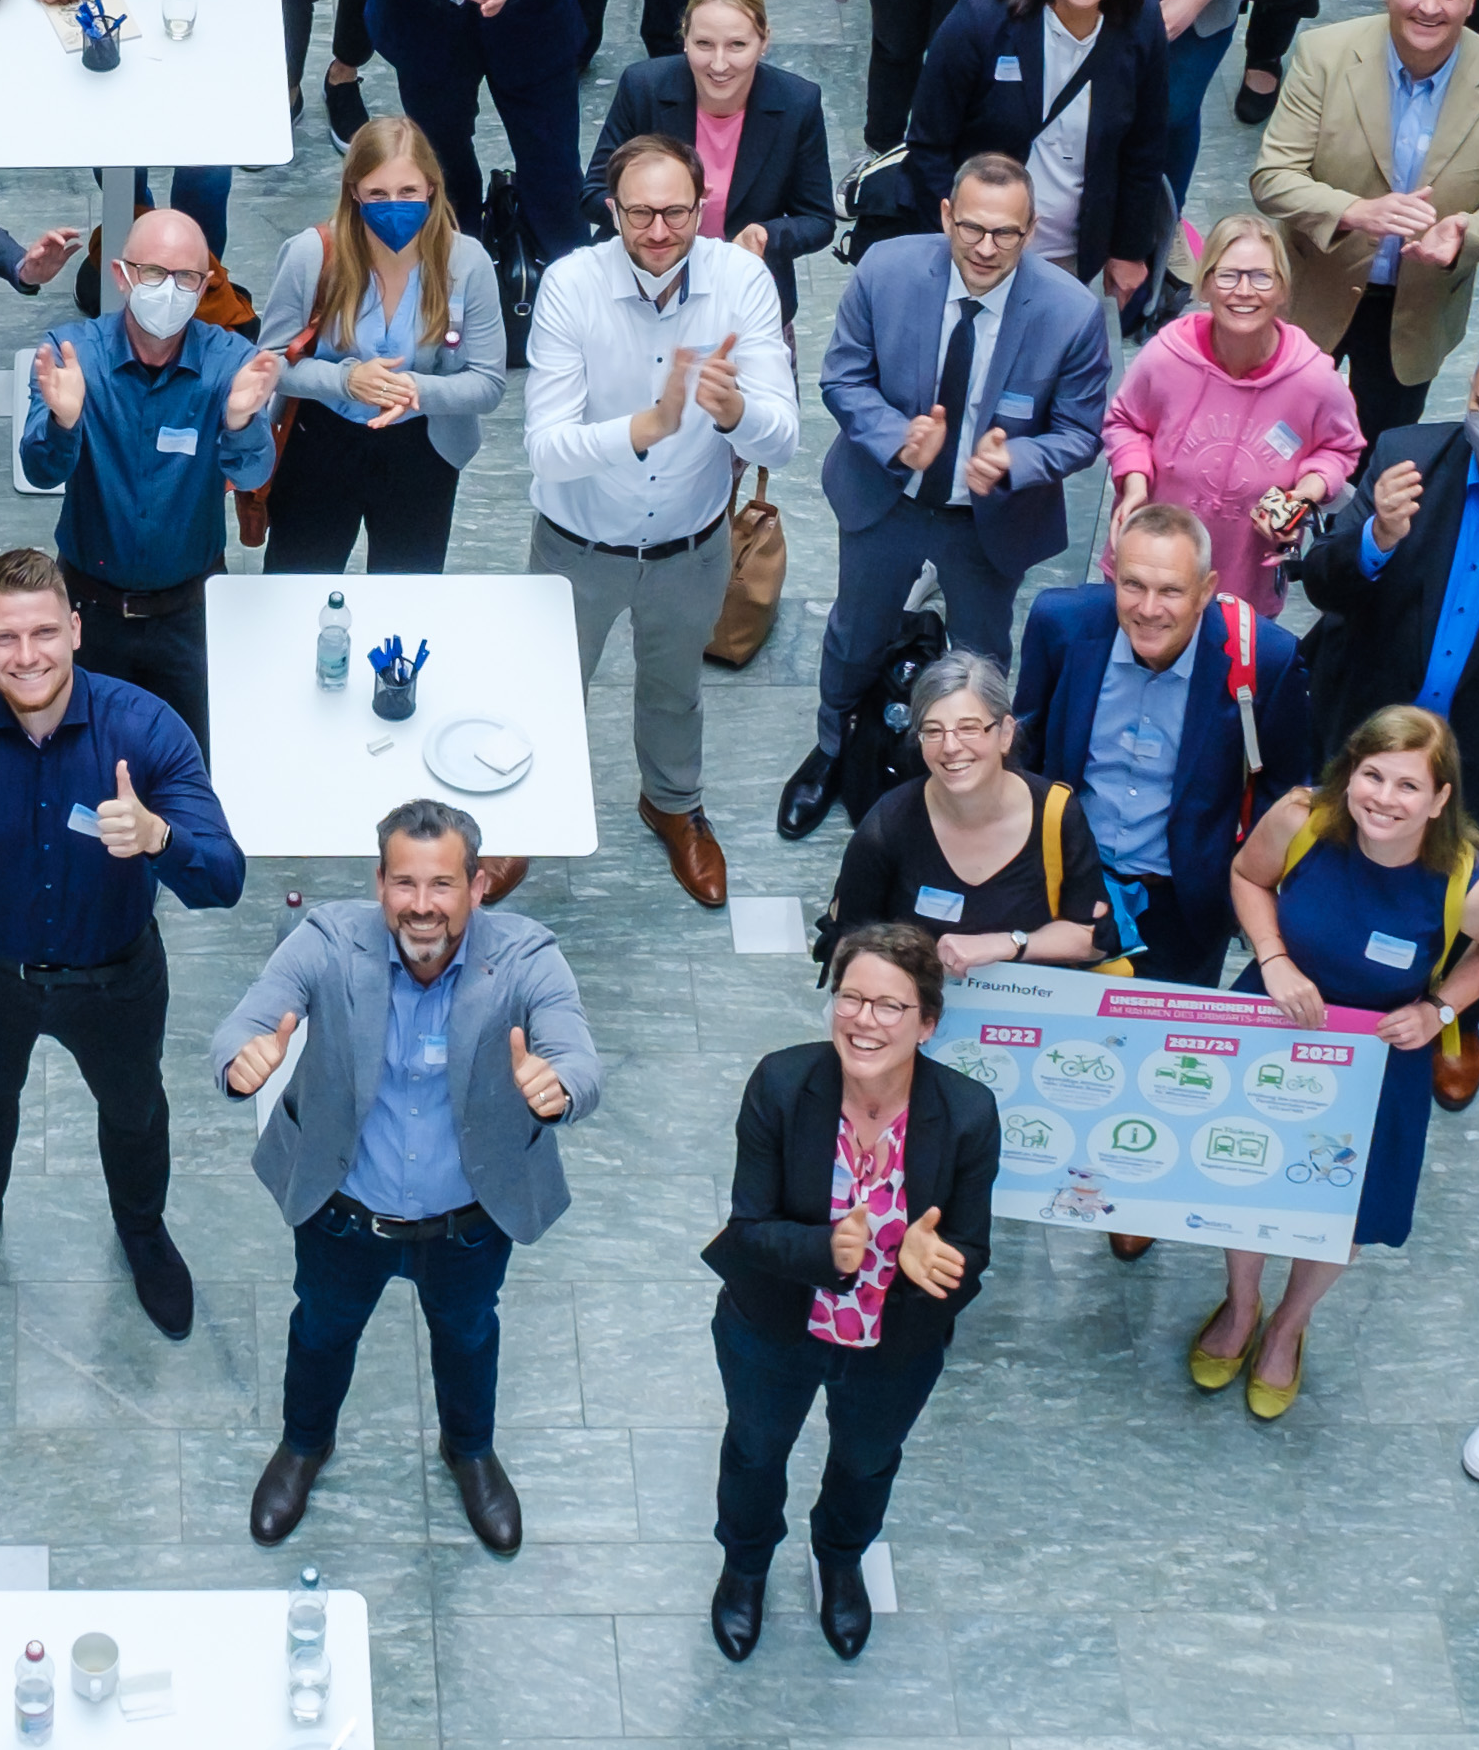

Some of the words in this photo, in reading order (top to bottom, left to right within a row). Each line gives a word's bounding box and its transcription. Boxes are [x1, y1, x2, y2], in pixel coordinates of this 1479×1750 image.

[967, 978, 1054, 998] Fraunhofer
[1109, 995, 1164, 1008] UNSERE
[1167, 998, 1254, 1014] AMBITIONEN
[985, 1028, 1036, 1044] 2022
[1169, 1037, 1235, 1052] 2023/24
[1295, 1045, 1348, 1062] 2025
